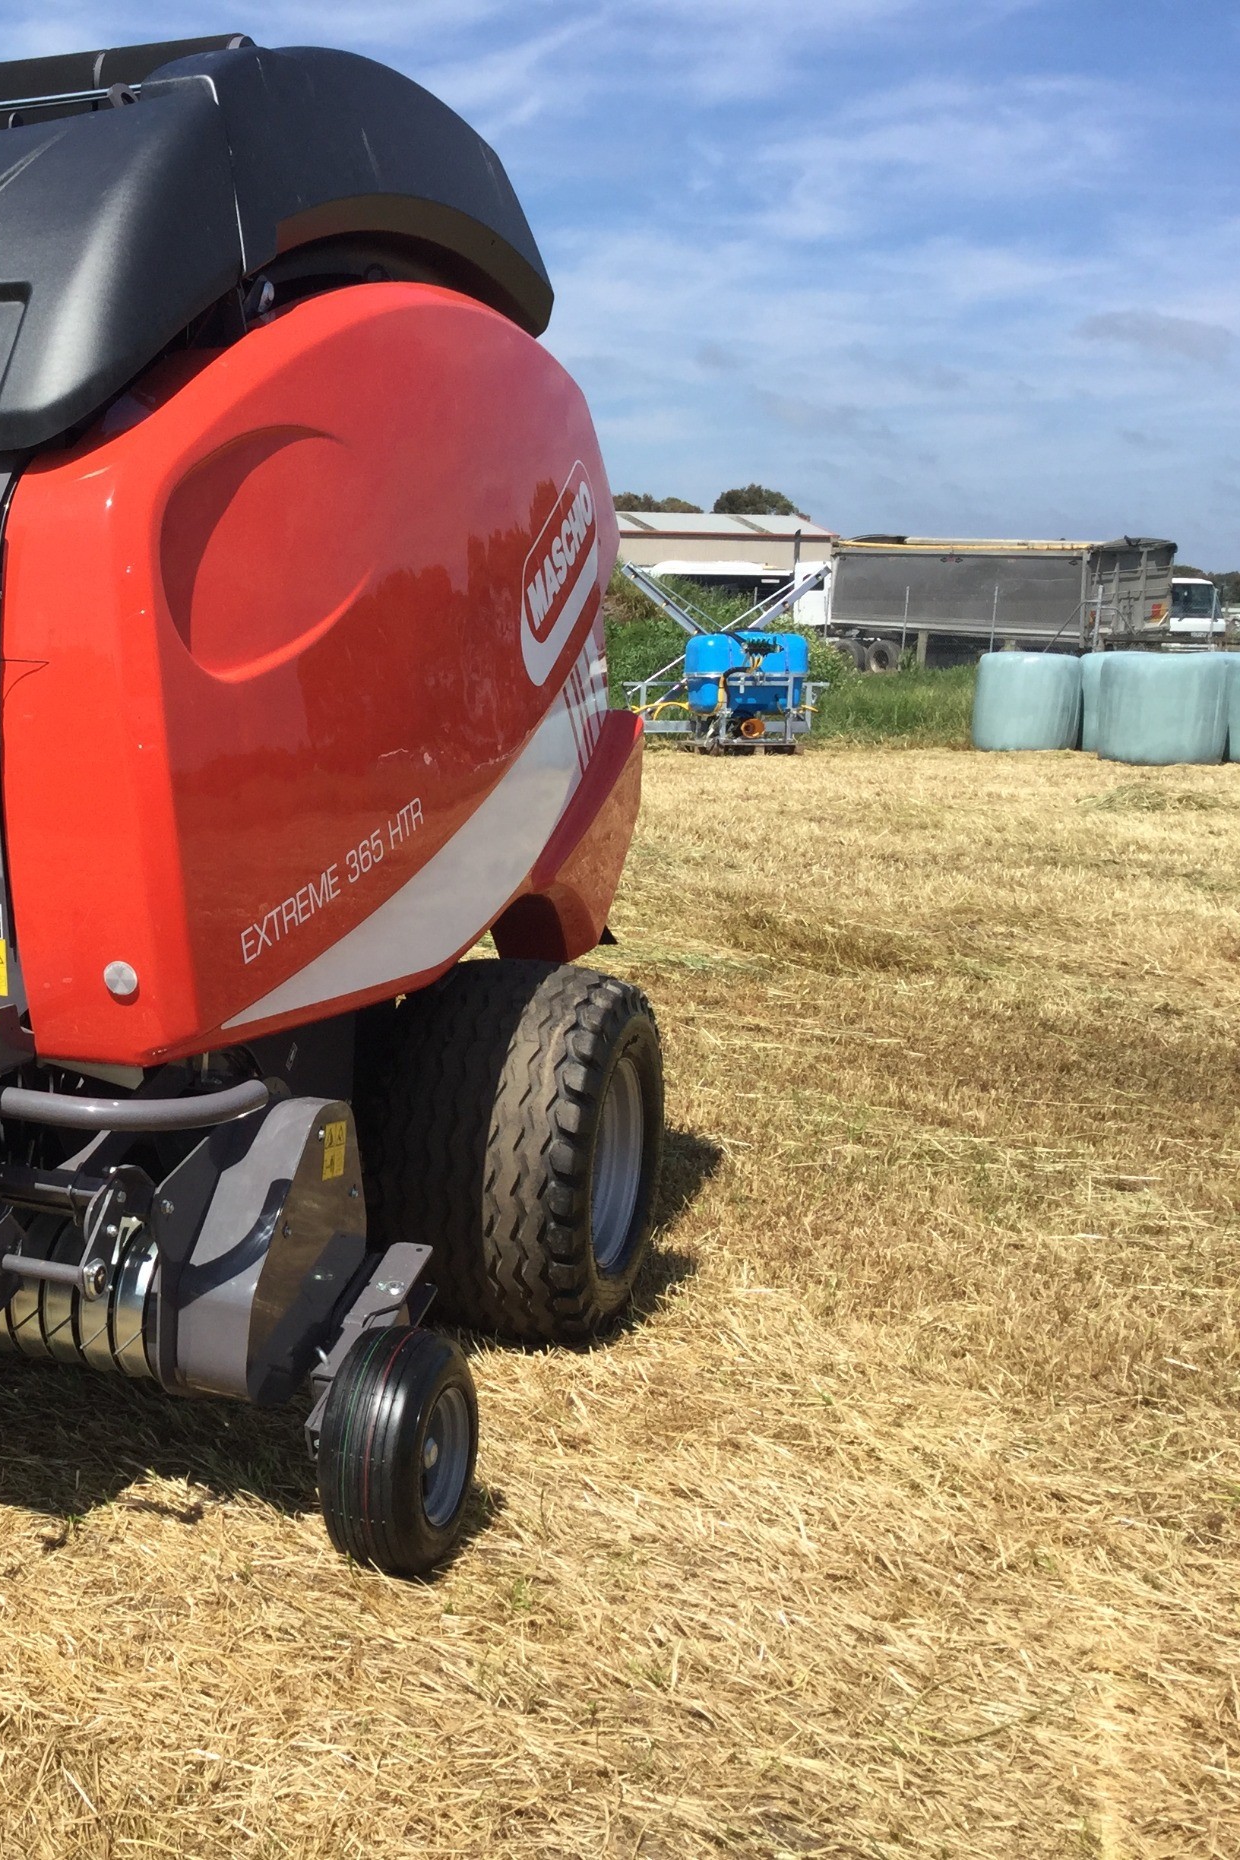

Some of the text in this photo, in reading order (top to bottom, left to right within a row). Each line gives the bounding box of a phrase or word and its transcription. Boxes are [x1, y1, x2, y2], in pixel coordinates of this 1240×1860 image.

[526, 481, 593, 631] MASCHIO
[240, 797, 424, 964] EXTREME 365 HTR
